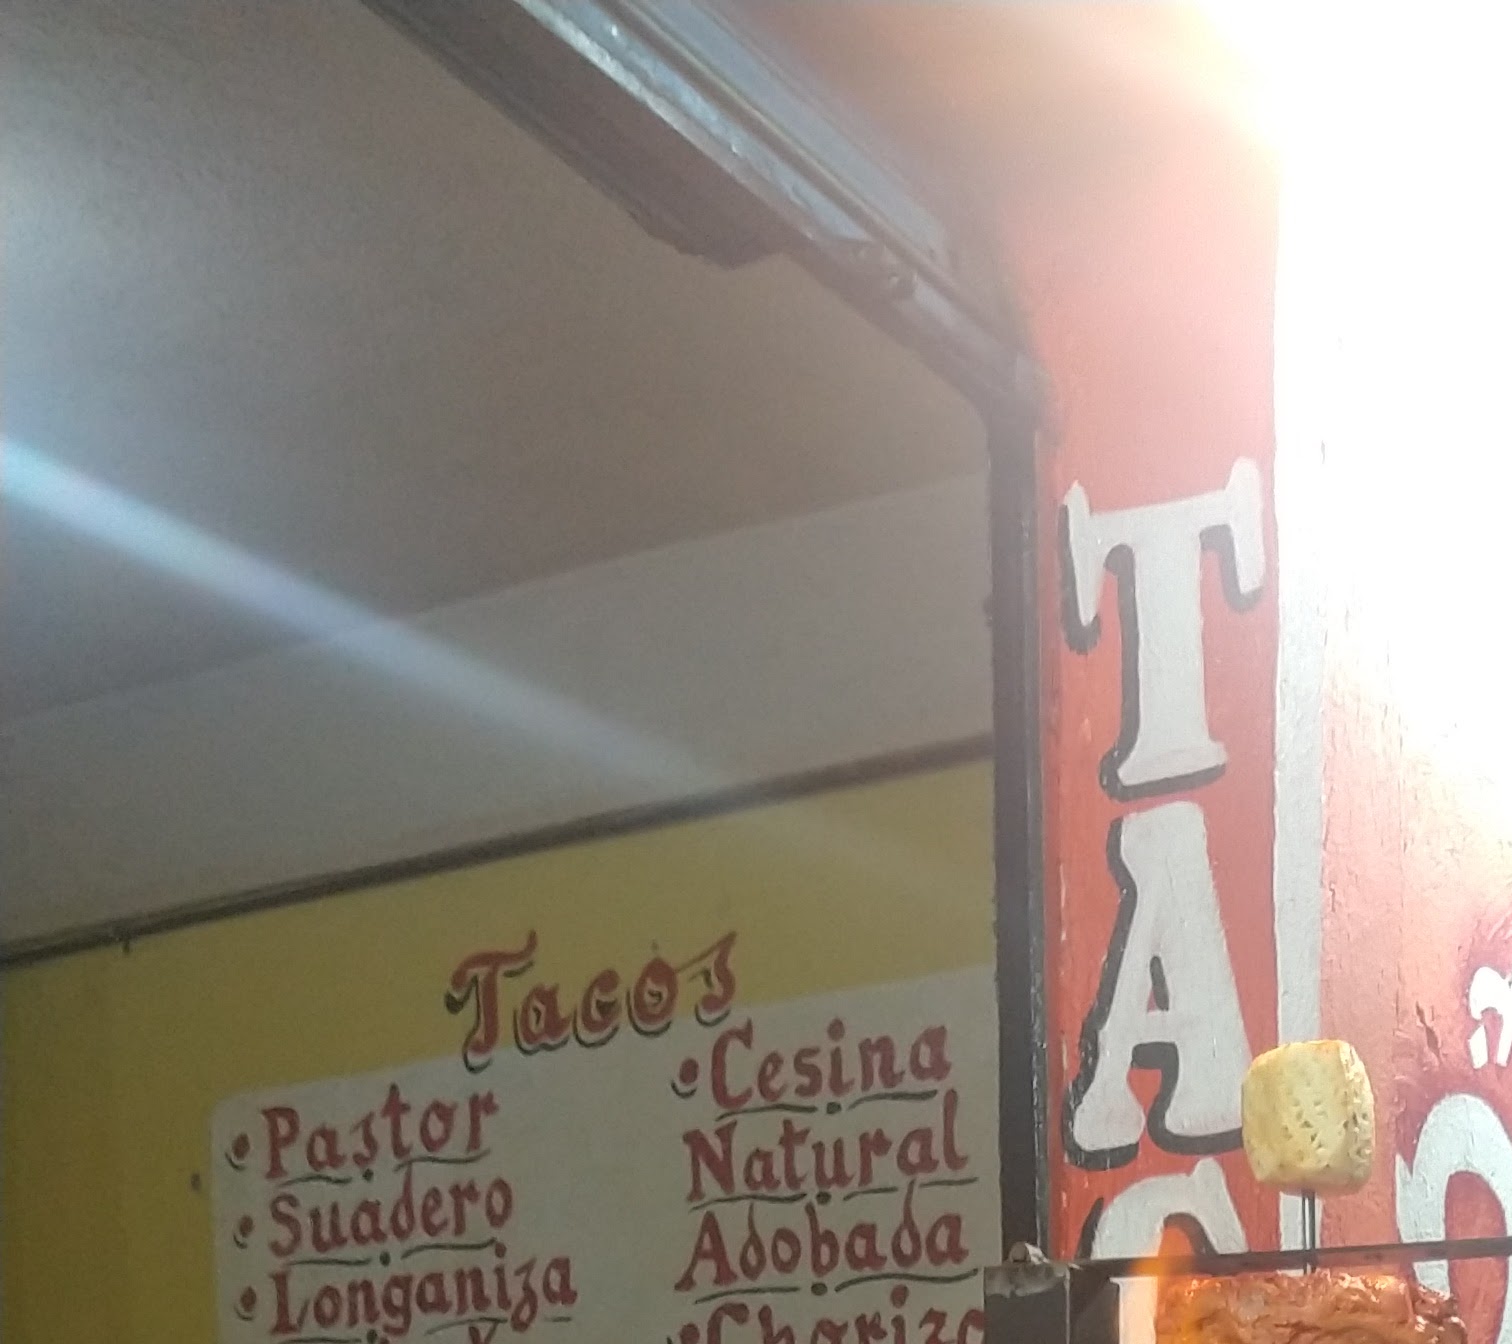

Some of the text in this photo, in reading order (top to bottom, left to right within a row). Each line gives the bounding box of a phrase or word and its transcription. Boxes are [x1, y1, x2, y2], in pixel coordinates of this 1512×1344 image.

[446, 931, 737, 1070] Tacos
[711, 1018, 951, 1109] Cesina
[262, 1083, 498, 1179] Pastor
[683, 1089, 968, 1200] Natural
[269, 1162, 512, 1258] Suadero
[675, 1179, 968, 1291] Adobada
[269, 1243, 576, 1337] Longaniza
